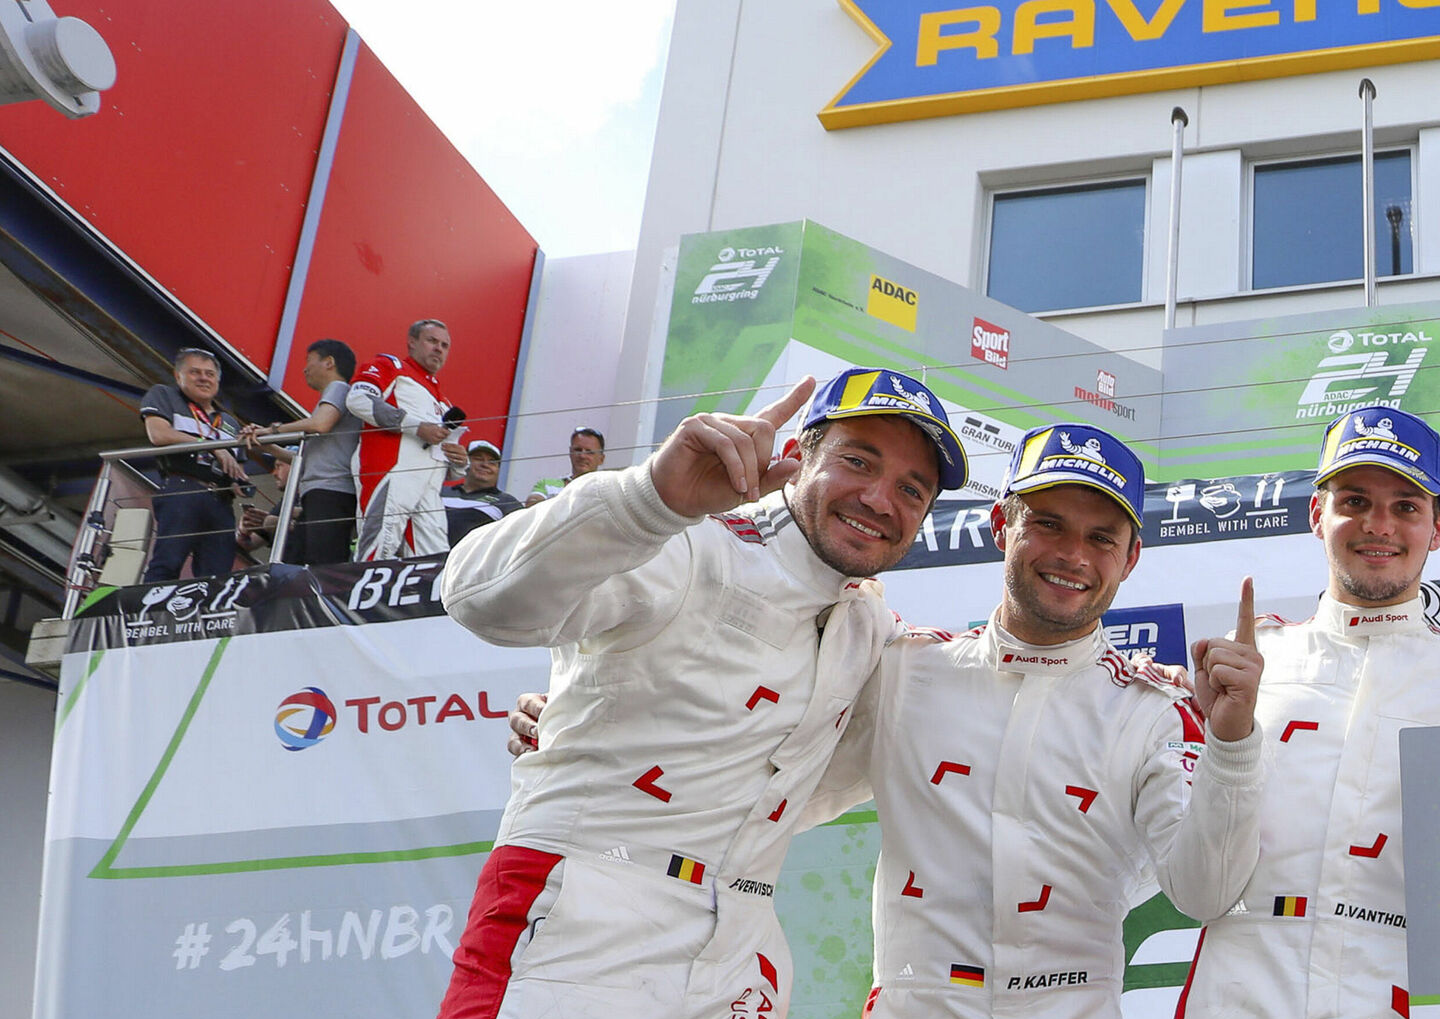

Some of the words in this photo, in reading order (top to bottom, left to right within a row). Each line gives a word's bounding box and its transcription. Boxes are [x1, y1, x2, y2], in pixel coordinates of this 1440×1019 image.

[737, 246, 784, 258] TOTAL
[692, 289, 758, 304] nürburgring
[872, 277, 916, 305] ADAC
[972, 326, 1009, 353] Sport
[1357, 331, 1432, 346] TOTAL
[985, 350, 1007, 368] Bild
[1324, 391, 1350, 400] ADAC
[961, 426, 990, 444] GRAN
[1336, 440, 1419, 462] MICHELIN
[1039, 457, 1126, 489] MICHELIN
[1159, 524, 1211, 538] BEMBEL
[1218, 519, 1249, 533] WITH
[1255, 515, 1289, 529] CARE
[1361, 614, 1383, 623] Audi
[1385, 613, 1408, 622] Sport
[125, 624, 170, 639] BEMBEL
[175, 620, 202, 635] WITH
[206, 618, 236, 632] CARE
[1015, 655, 1038, 664] Audi
[1040, 657, 1068, 666] Sport
[345, 691, 509, 734] TOTAL
[172, 904, 455, 971] #24hNBR
